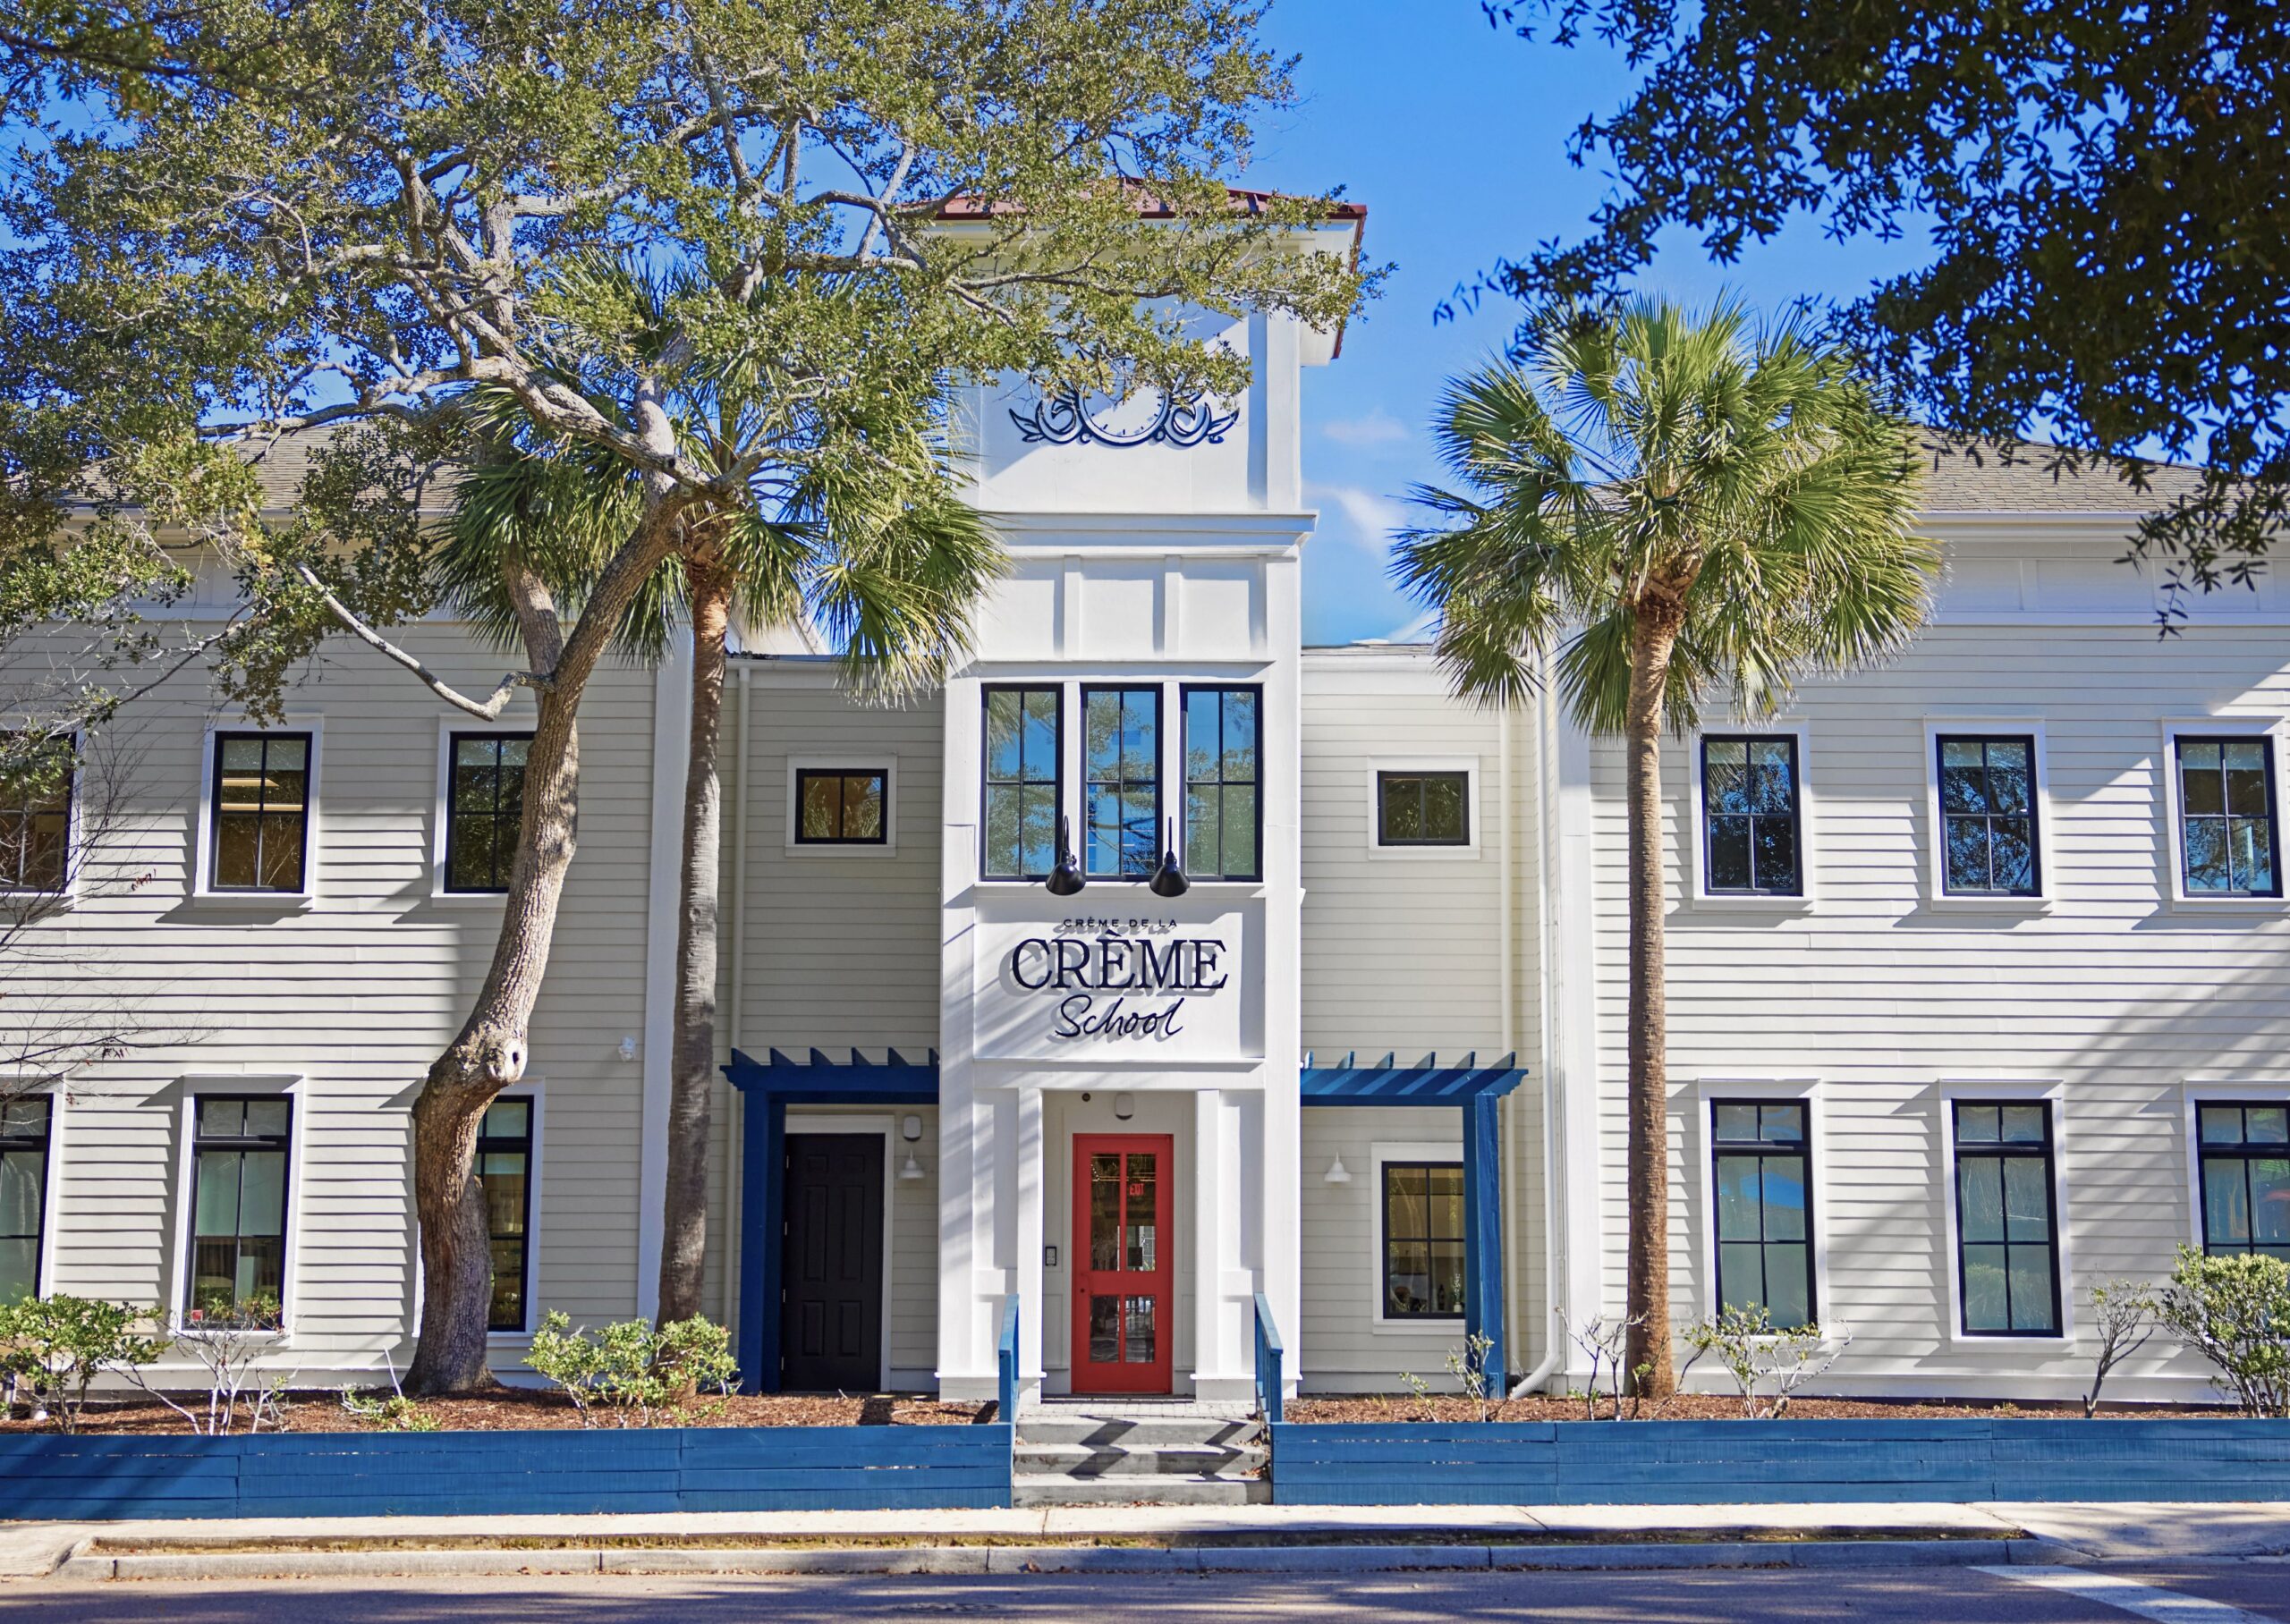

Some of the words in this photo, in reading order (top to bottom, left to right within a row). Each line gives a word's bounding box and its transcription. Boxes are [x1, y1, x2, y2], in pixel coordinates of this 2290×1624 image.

[1063, 917, 1119, 928] CRÈME
[1129, 918, 1149, 928] DE
[1158, 918, 1177, 928] LA
[1012, 929, 1228, 990] CRÈME
[1056, 994, 1185, 1038] School
